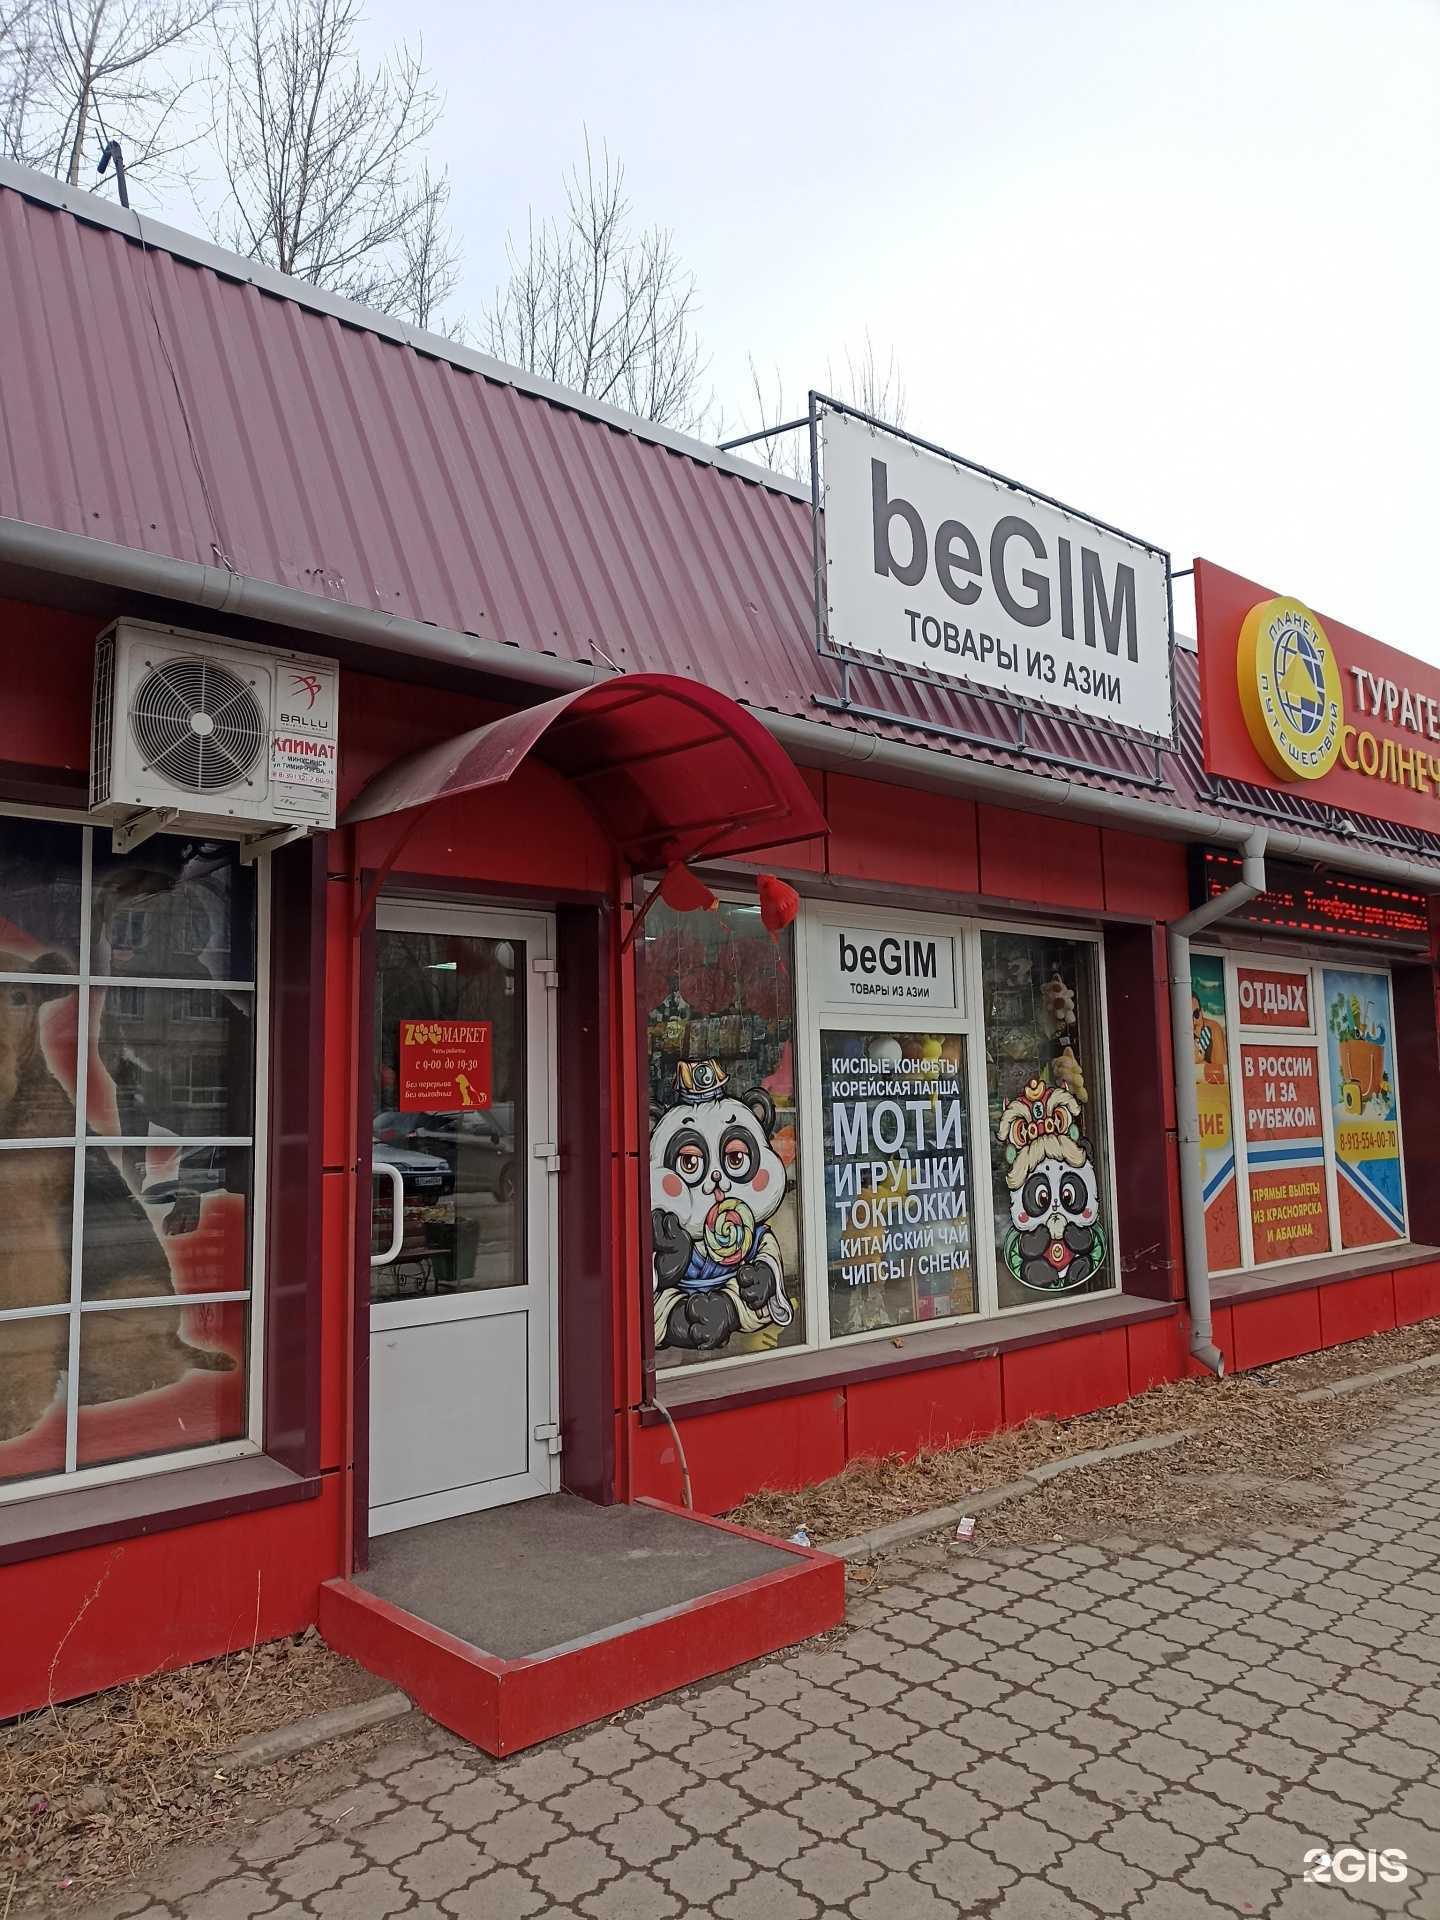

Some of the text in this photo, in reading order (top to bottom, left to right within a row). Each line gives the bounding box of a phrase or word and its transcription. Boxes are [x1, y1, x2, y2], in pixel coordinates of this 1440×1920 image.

[871, 457, 1139, 663] beGIM
[1268, 610, 1325, 664] ПЛАНЕТА
[904, 608, 1121, 704] ТОВАРЫ ИЗ АЗИИ
[1350, 665, 1440, 740] ТУРАГЕ
[280, 713, 328, 729] BALLU
[272, 735, 335, 760] КЛИМАТ
[839, 933, 937, 979] beGIM
[850, 983, 930, 998] ТОВАРЫ ИЗ АЗИИ
[1239, 980, 1306, 1015] ОТДЫХ
[444, 1057, 455, 1070] до
[832, 1057, 959, 1075] КИСЛЫЕ КОНФЕТЫ
[1244, 1056, 1313, 1078] В РОССИИ
[832, 1077, 960, 1097] КОРЕЙСКАЯ ЛАПША
[1265, 1082, 1298, 1103] И ЗА
[832, 1099, 963, 1156] МОТИ
[1248, 1106, 1316, 1130] РУБЕЖОМ
[834, 1156, 966, 1197] ИГРУШКИ
[1252, 1181, 1321, 1202] ПРЯМЫЕ ВЫЛЕТЫ
[835, 1190, 967, 1231] ТОКПОККИ
[1253, 1201, 1323, 1224] ИЗ КРАСНОЯРСКА
[840, 1220, 969, 1259] КИТАЙСКИЙ ЧАЙ
[1266, 1223, 1313, 1242] И АБАКАНА
[842, 1250, 970, 1286] ЧИПСЫ / СНЕКИ
